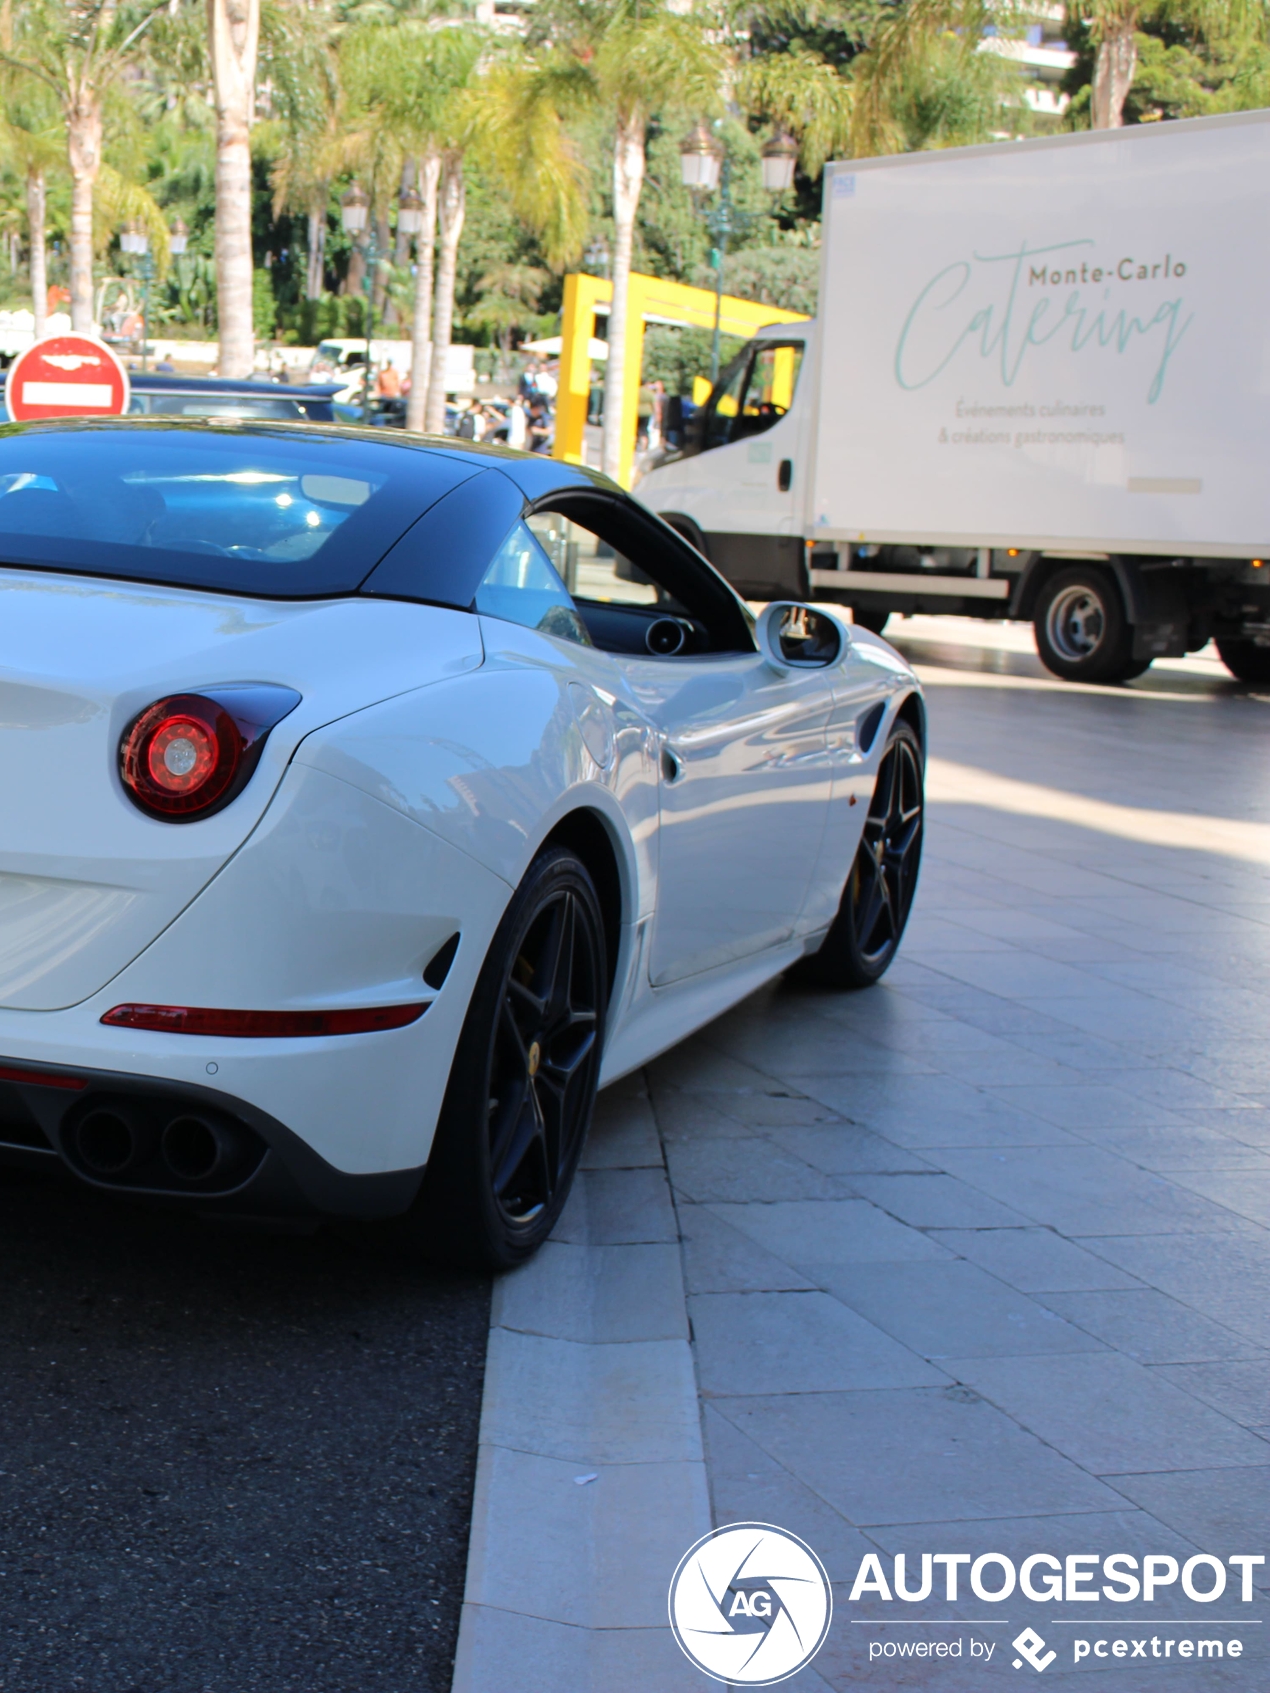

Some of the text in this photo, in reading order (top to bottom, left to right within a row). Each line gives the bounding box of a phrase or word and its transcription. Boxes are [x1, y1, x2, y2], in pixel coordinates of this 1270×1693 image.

[1028, 254, 1187, 287] Monte-Carlo
[894, 239, 1196, 405] Catering
[1039, 399, 1106, 418] culinaires
[951, 428, 1011, 444] créations
[1014, 429, 1126, 449] gastronomiques
